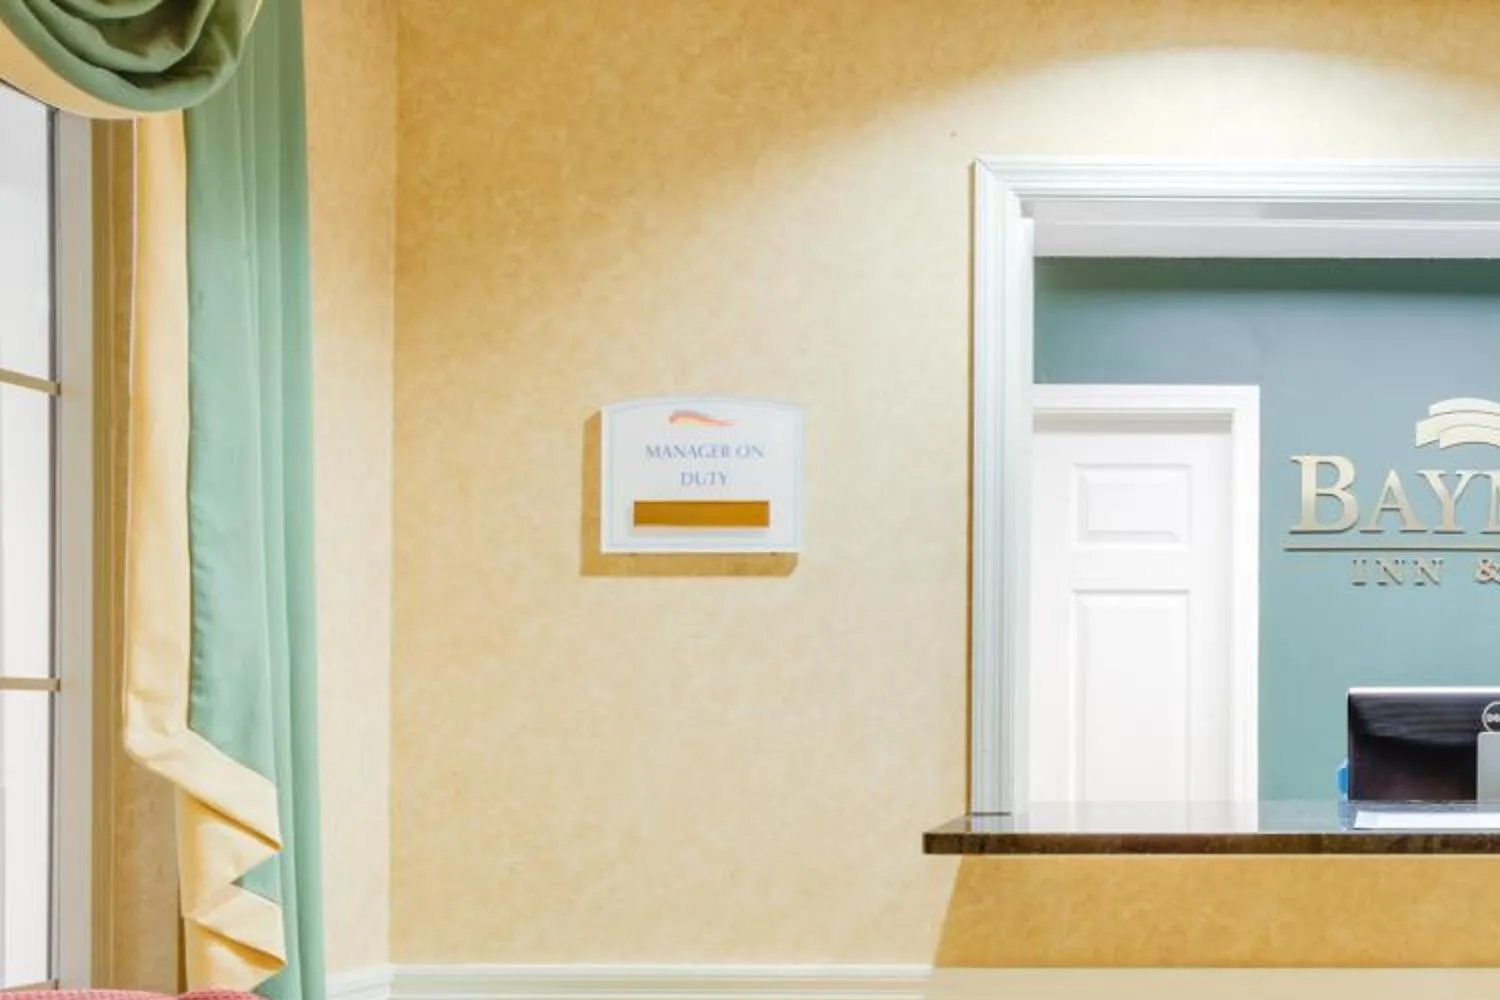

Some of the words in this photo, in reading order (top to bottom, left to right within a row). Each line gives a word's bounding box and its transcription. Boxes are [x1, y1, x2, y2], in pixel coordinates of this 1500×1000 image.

[645, 444, 731, 459] MANAGER
[735, 445, 764, 459] ON
[680, 471, 730, 488] DUTY
[1352, 558, 1443, 586] INN
